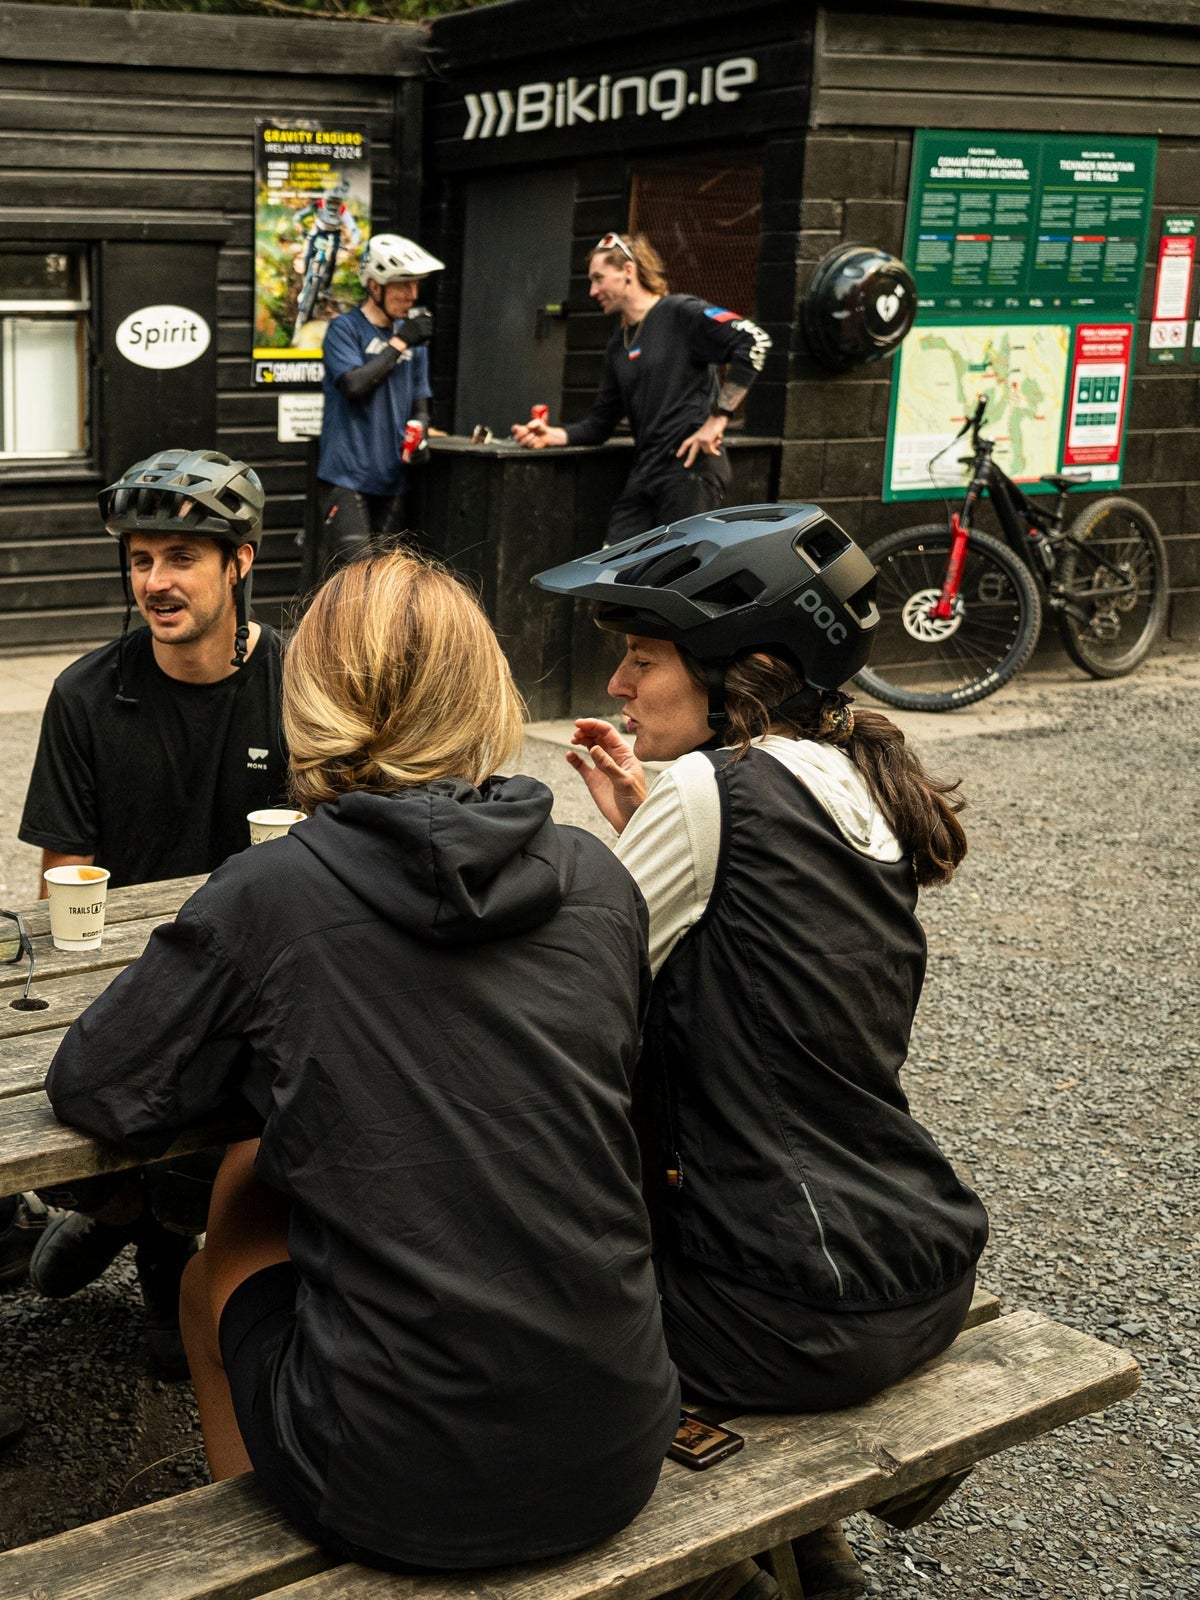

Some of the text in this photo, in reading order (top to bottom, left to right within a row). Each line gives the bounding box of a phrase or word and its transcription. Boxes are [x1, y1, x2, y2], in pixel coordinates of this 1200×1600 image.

[515, 57, 758, 133] Biking.ie
[263, 129, 363, 145] GRAVITY ENDURO
[264, 143, 362, 159] IRELAND SERIES 2024
[129, 320, 198, 351] Spirit
[247, 761, 268, 771] MONS
[69, 906, 90, 915] TRAILS
